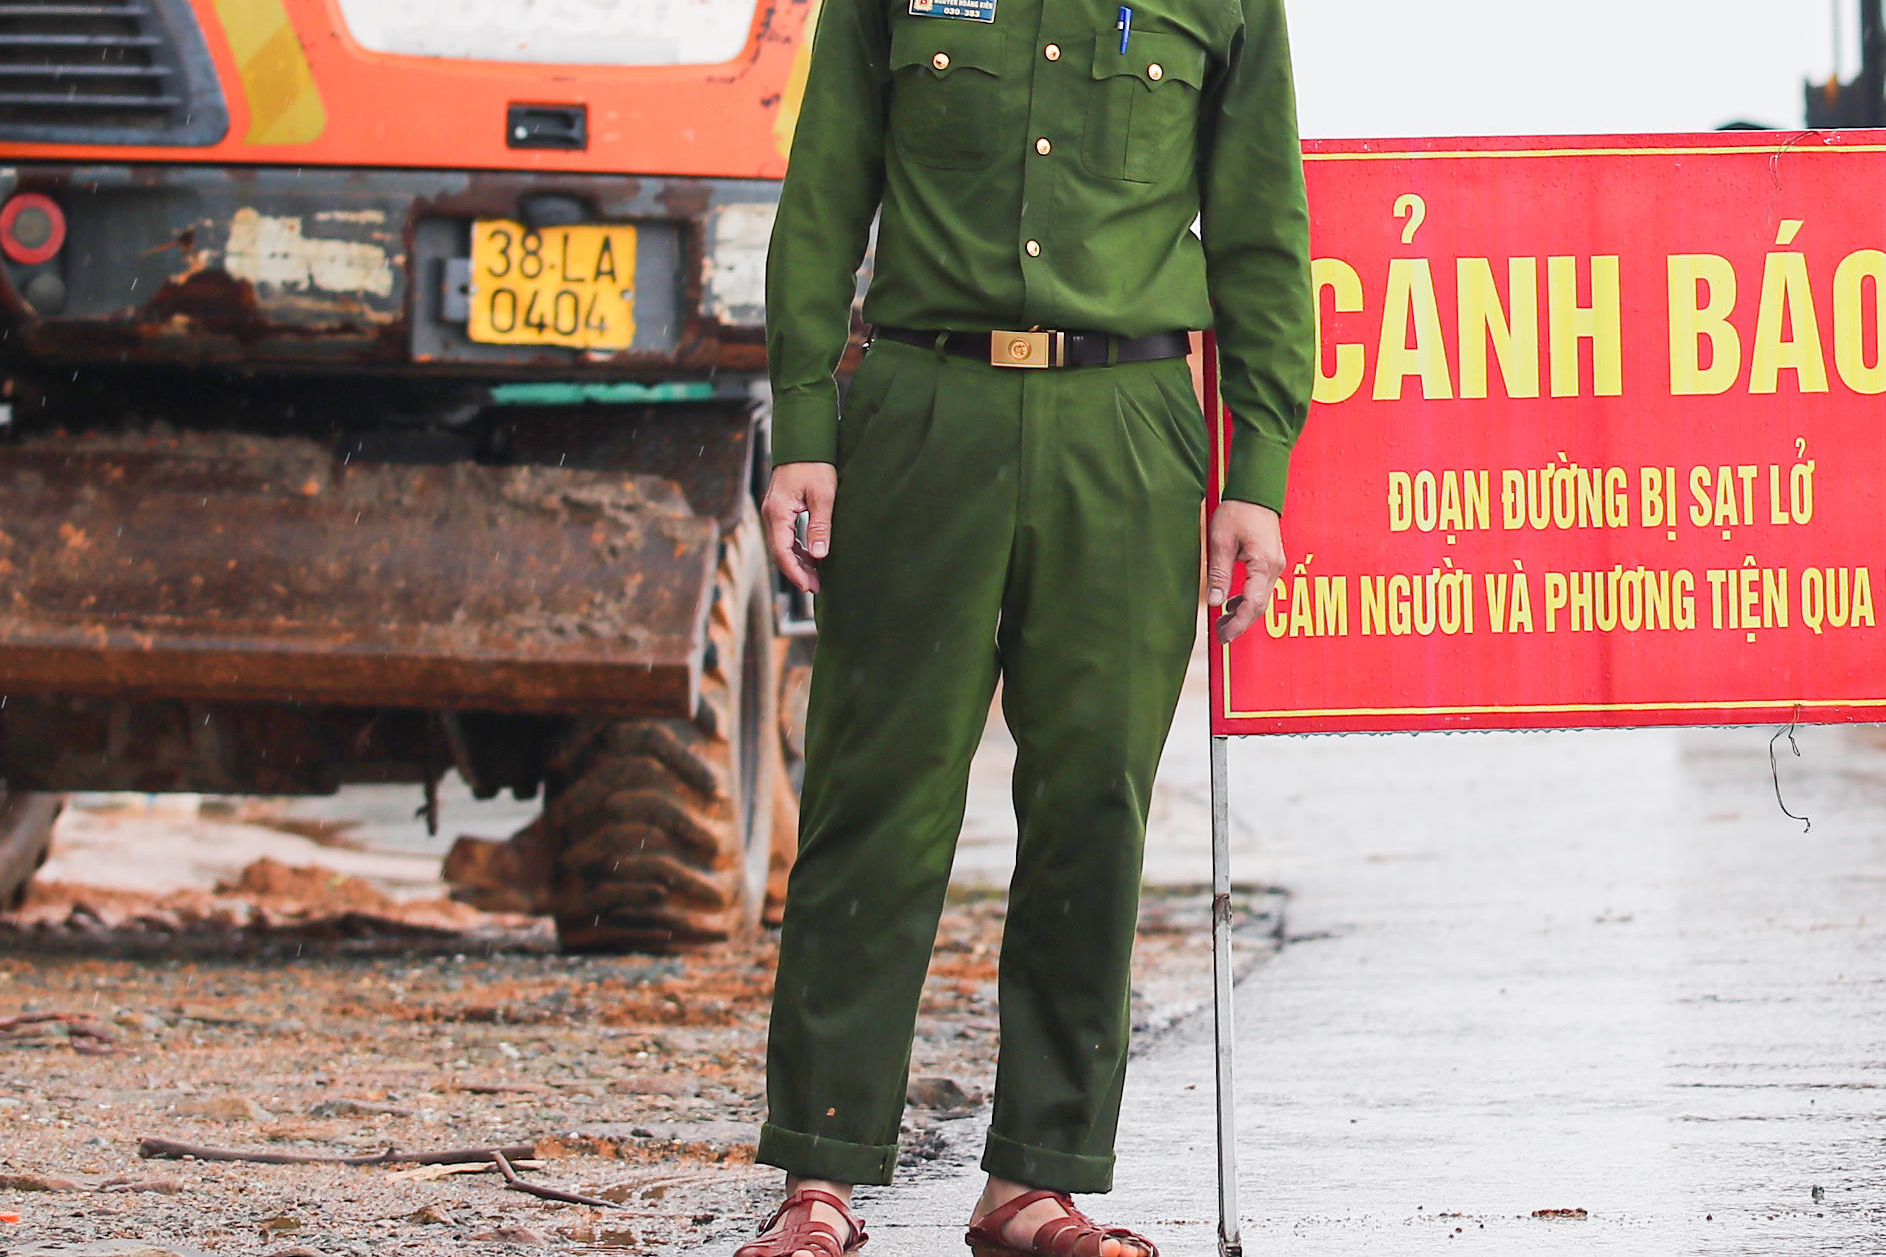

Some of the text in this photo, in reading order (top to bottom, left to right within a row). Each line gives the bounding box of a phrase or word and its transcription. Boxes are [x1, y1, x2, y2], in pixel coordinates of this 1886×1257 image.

[490, 287, 607, 336] 0404
[1310, 193, 1624, 404] CẢNH
[1387, 436, 1817, 546] ĐOẠN ĐƯỜNG BỊ SẠT LỞ
[1264, 553, 1349, 638] CẤM
[1360, 557, 1475, 636] NGƯỜI
[1485, 557, 1535, 634] VÀ
[1544, 563, 1697, 633] PHƯƠNG
[1706, 554, 1790, 644] TIỆN
[1800, 566, 1877, 636] QUA
